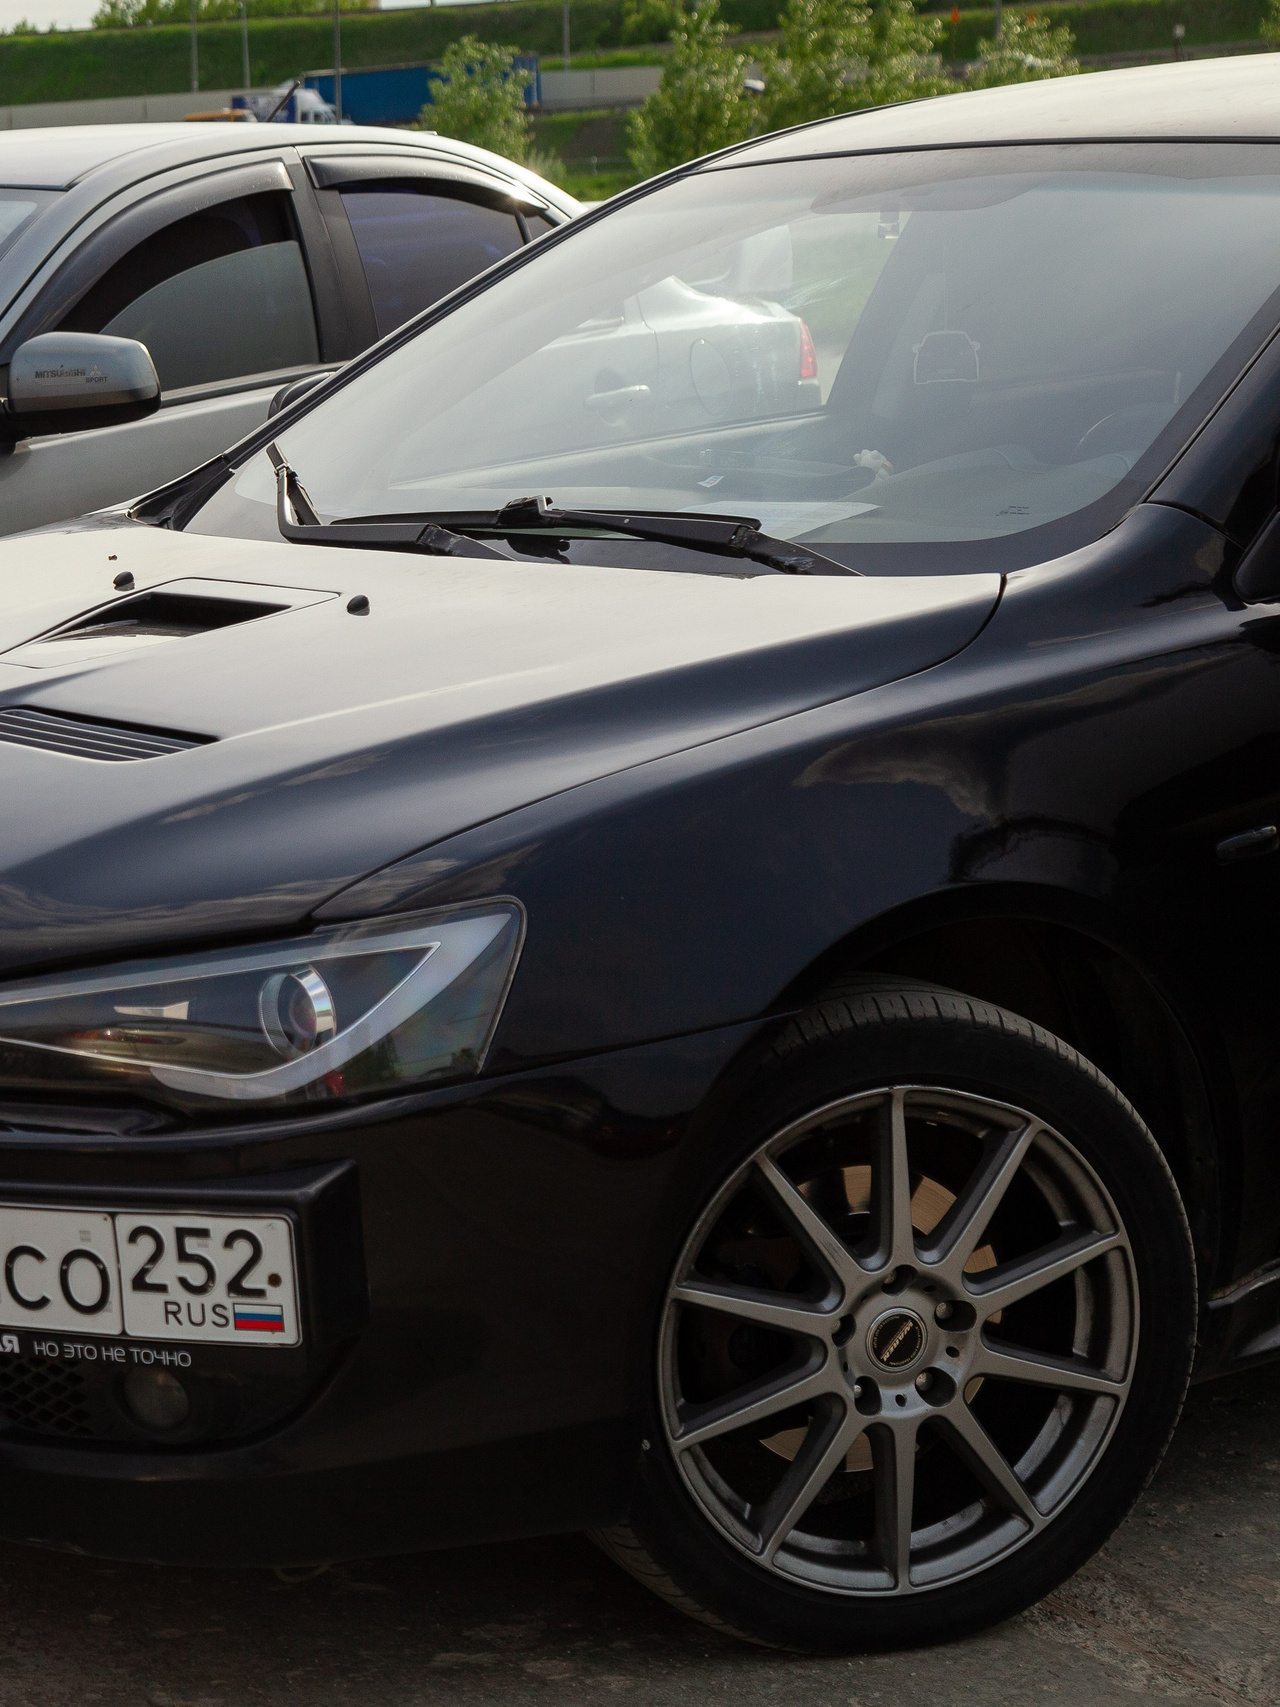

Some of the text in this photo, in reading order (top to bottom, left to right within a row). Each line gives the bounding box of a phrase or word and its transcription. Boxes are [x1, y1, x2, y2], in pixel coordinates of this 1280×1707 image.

[127, 1225, 268, 1299] 252
[164, 1301, 231, 1328] RUS
[33, 1341, 59, 1357] НО
[62, 1342, 98, 1361] ЭТО
[130, 1347, 192, 1367] ТОЧНО
